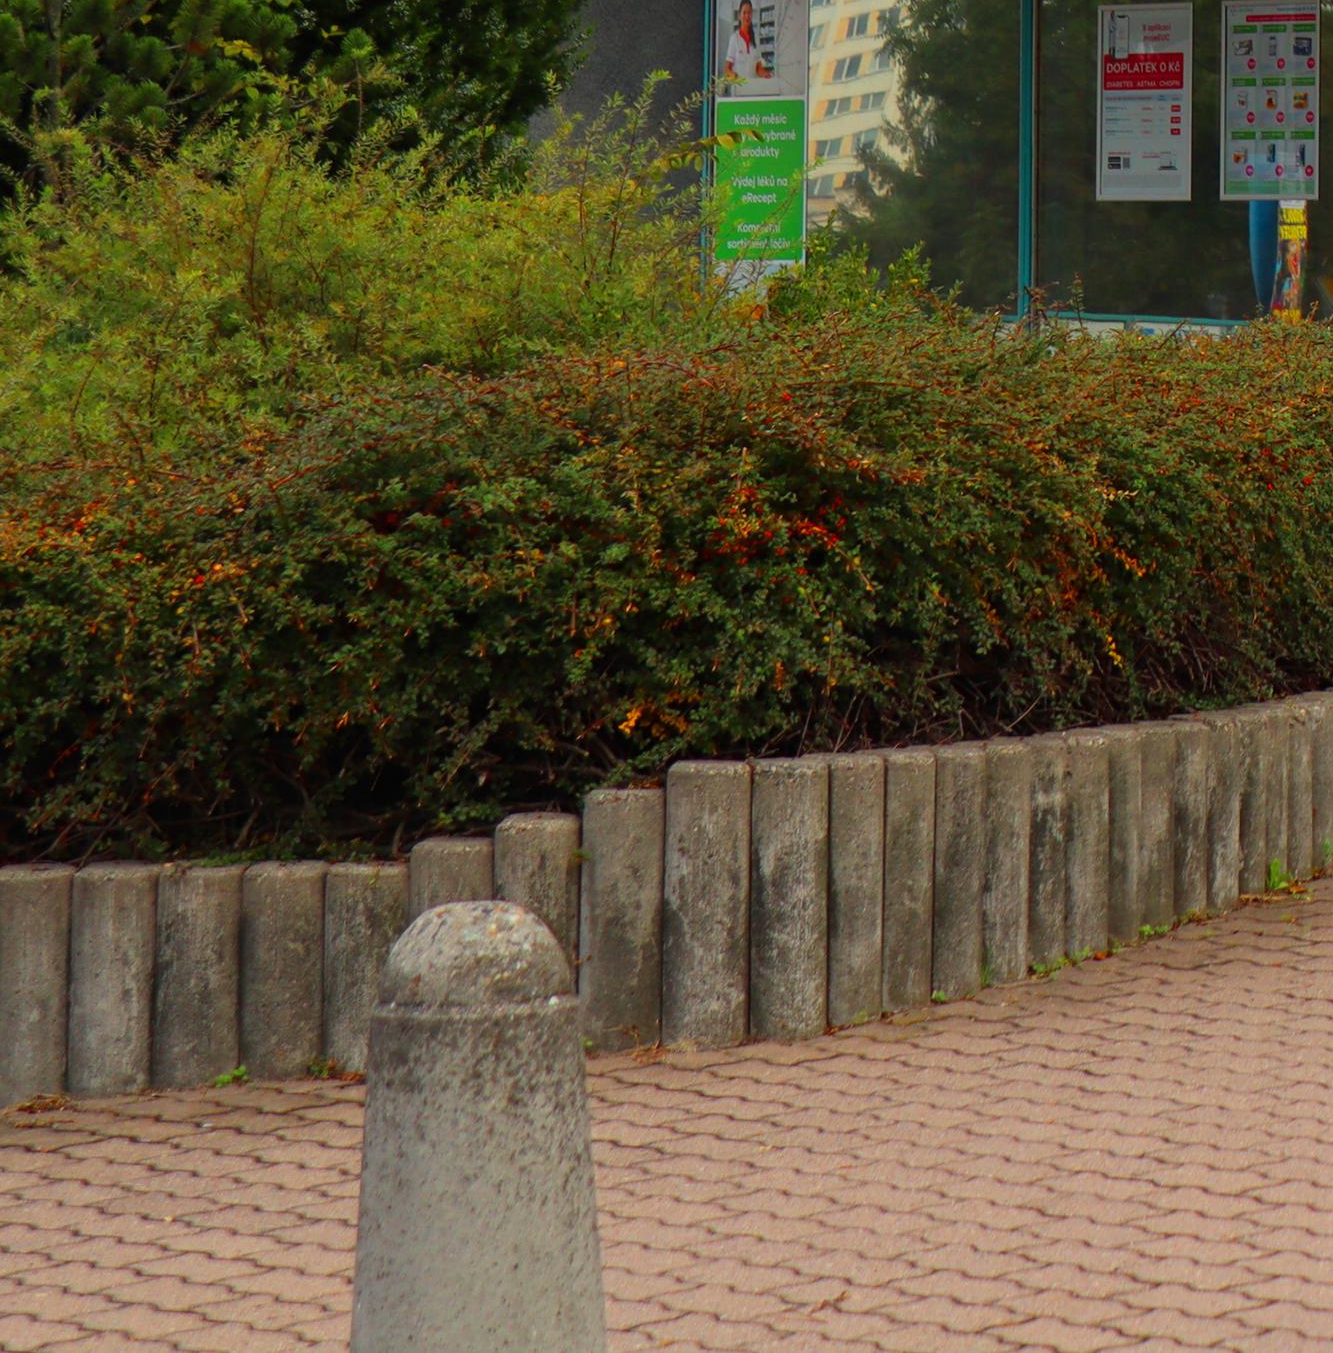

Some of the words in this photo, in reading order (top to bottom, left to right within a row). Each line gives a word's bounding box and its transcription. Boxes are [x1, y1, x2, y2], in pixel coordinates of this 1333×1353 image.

[1106, 61, 1157, 74] DOPLATEK
[1159, 61, 1167, 73] 0
[734, 114, 760, 127] Každý
[776, 178, 787, 187] na
